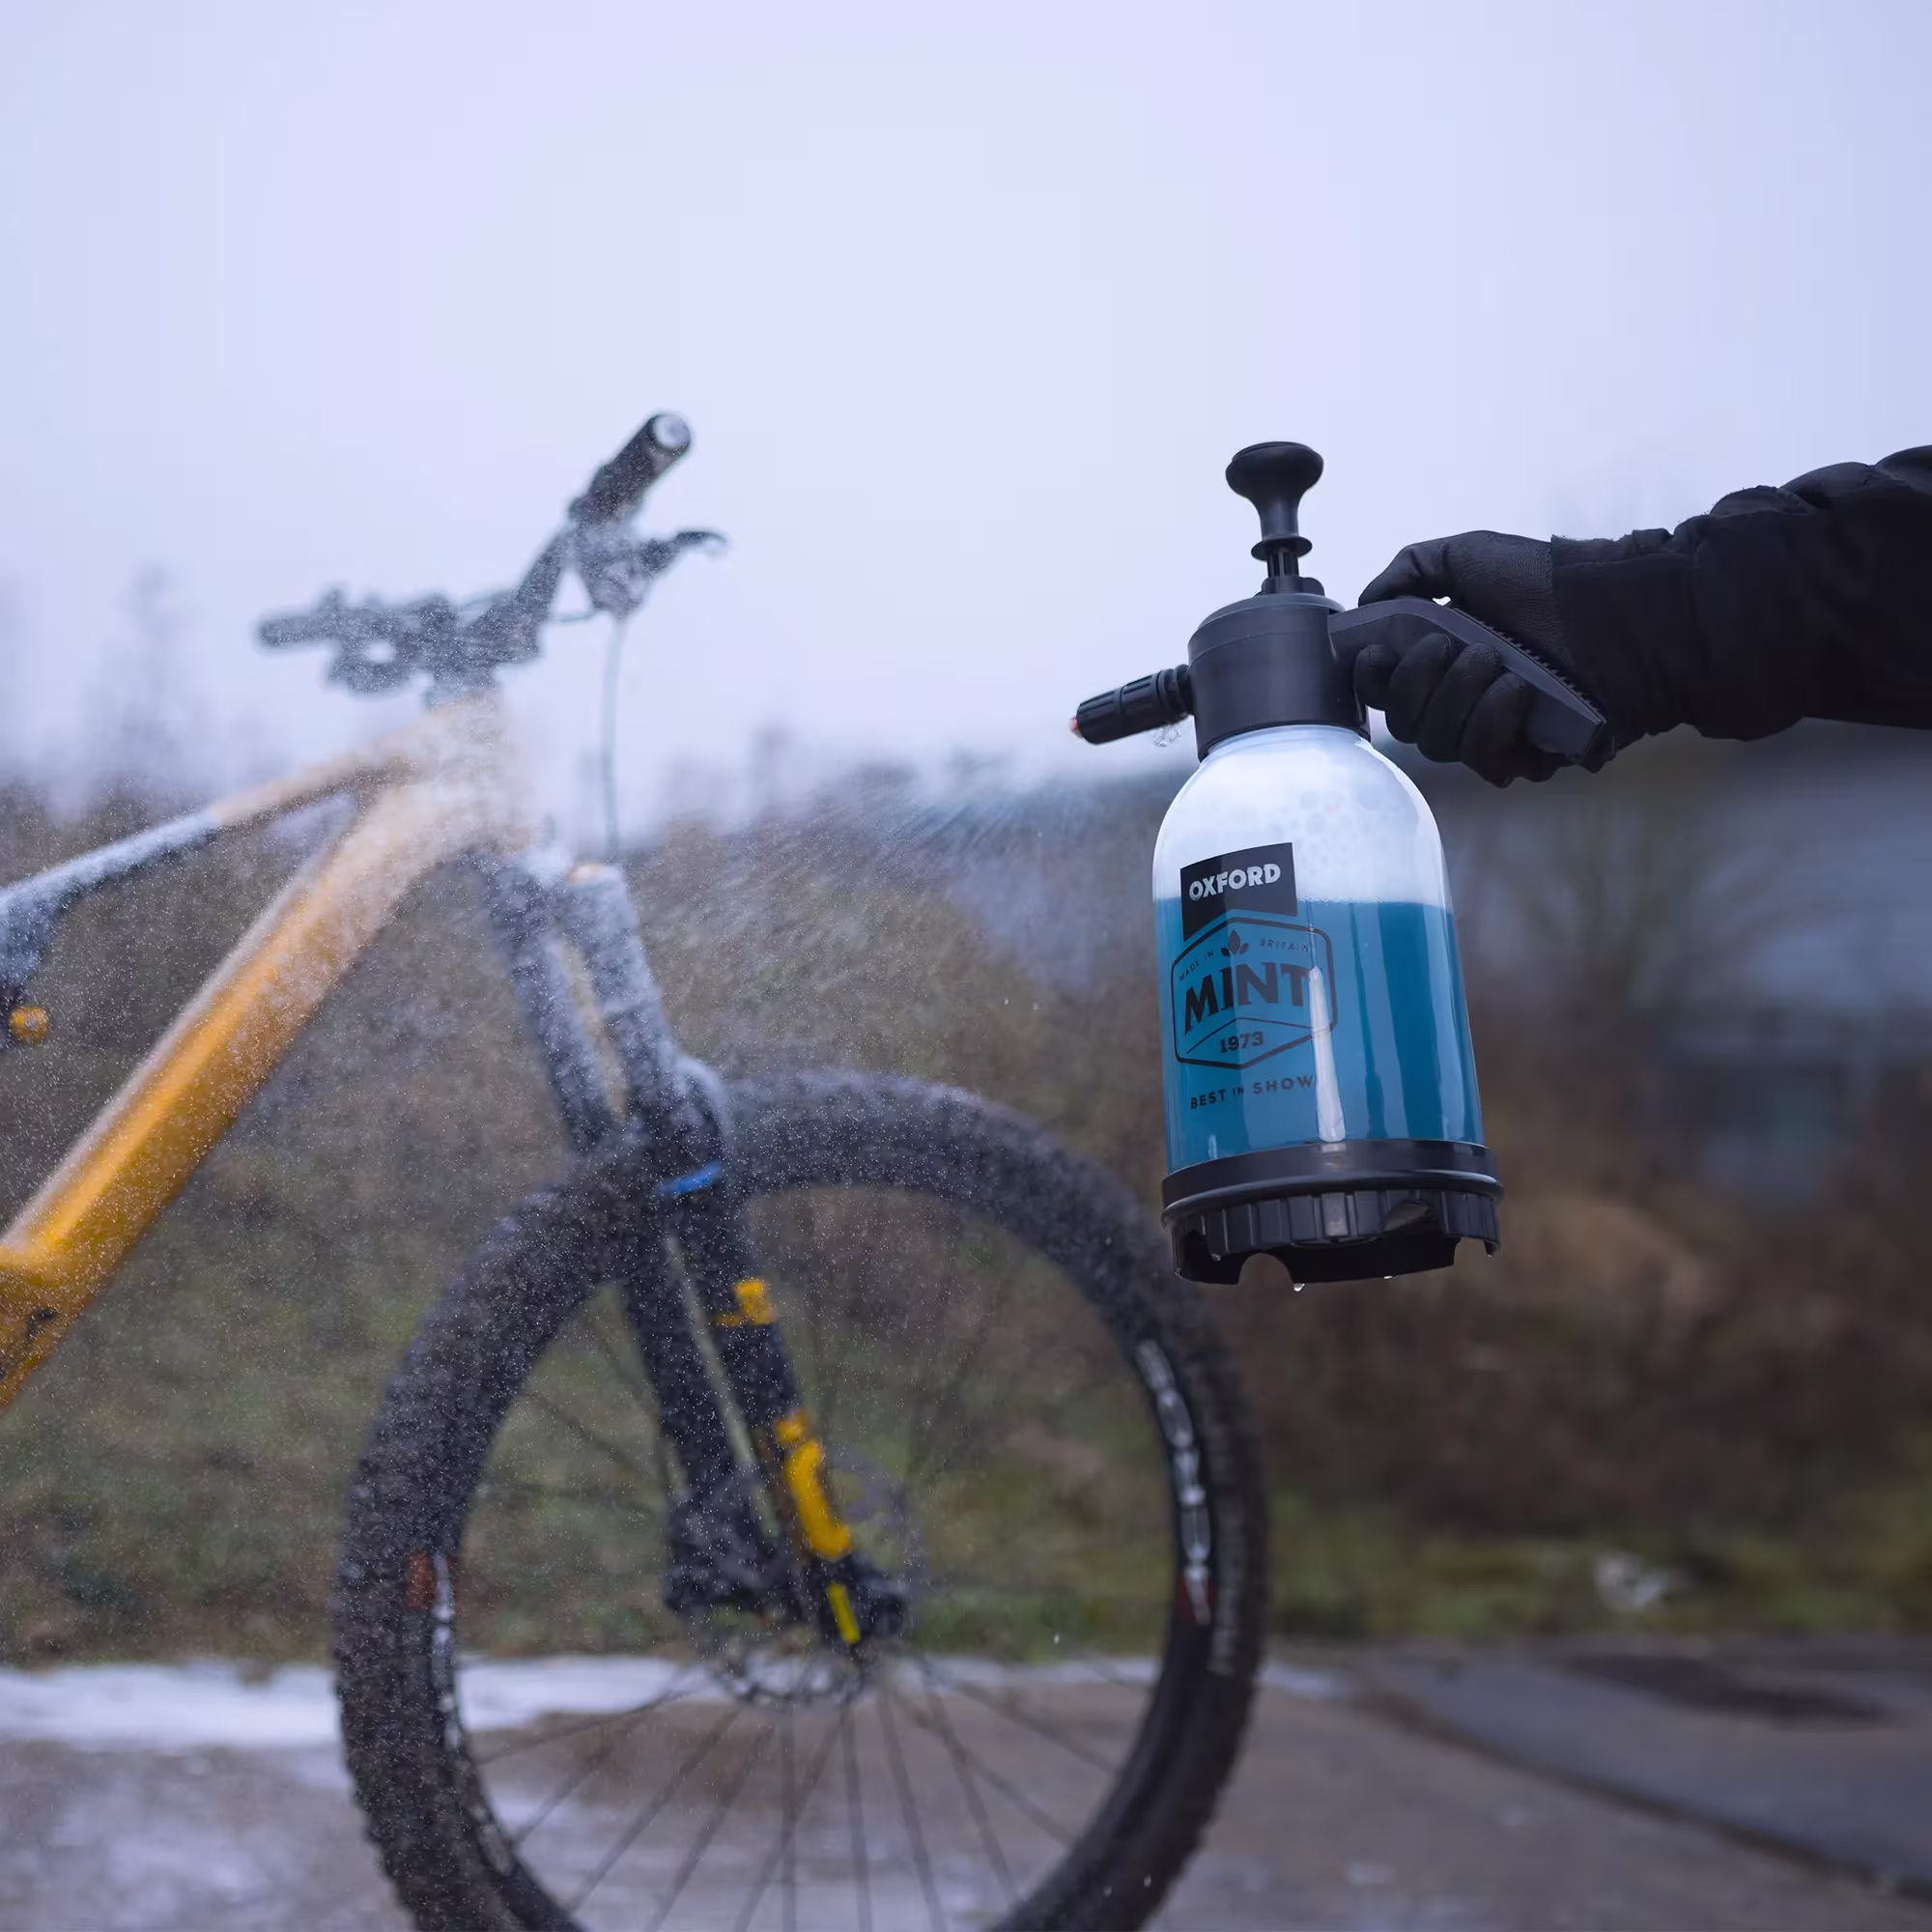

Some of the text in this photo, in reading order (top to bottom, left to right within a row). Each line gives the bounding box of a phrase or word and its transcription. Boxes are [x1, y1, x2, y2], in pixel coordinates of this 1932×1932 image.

[1188, 863, 1282, 901] OXFORD
[1179, 960, 1200, 981] MADE
[1204, 950, 1214, 962] IN
[1184, 961, 1316, 1036] MINT
[1219, 1031, 1264, 1054] 1973
[1190, 1075, 1314, 1109] BEST IN SHOW
